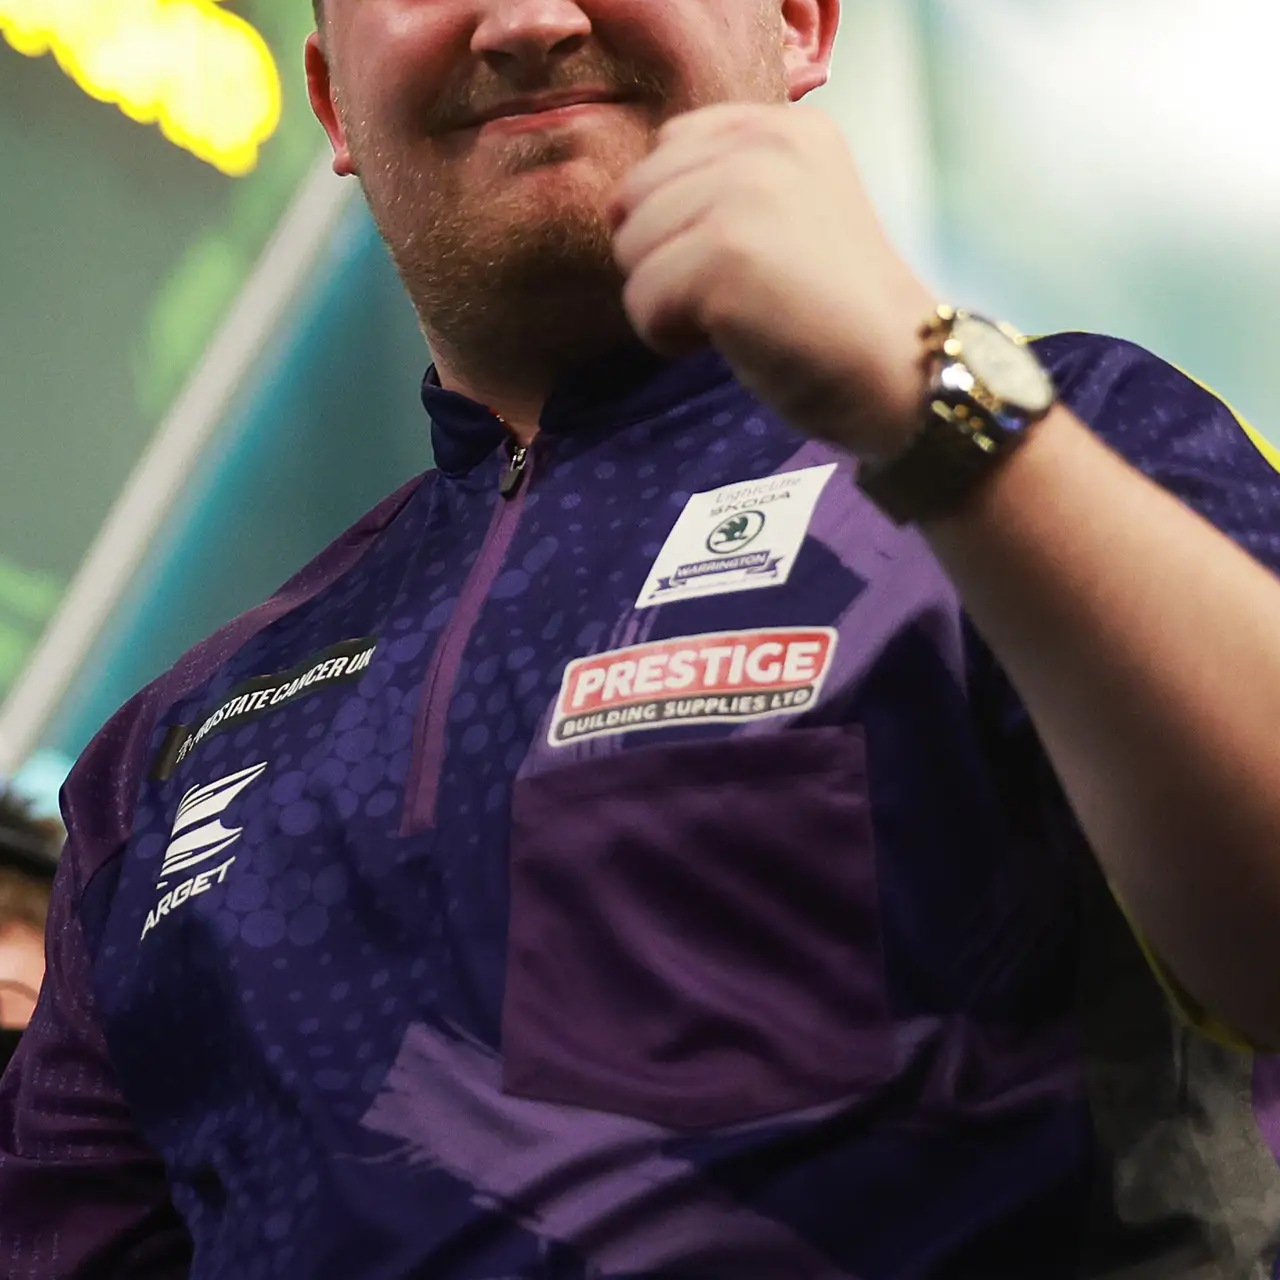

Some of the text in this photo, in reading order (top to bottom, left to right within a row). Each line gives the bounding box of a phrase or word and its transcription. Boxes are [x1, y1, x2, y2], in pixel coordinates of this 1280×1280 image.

[677, 552, 767, 578] WARRINGTON
[270, 657, 349, 705] CANCER
[346, 646, 376, 674] UK
[572, 641, 820, 709] PRESTIGE
[562, 688, 811, 736] BUILDING SUPPLIES LTD
[140, 856, 236, 941] ARGET
